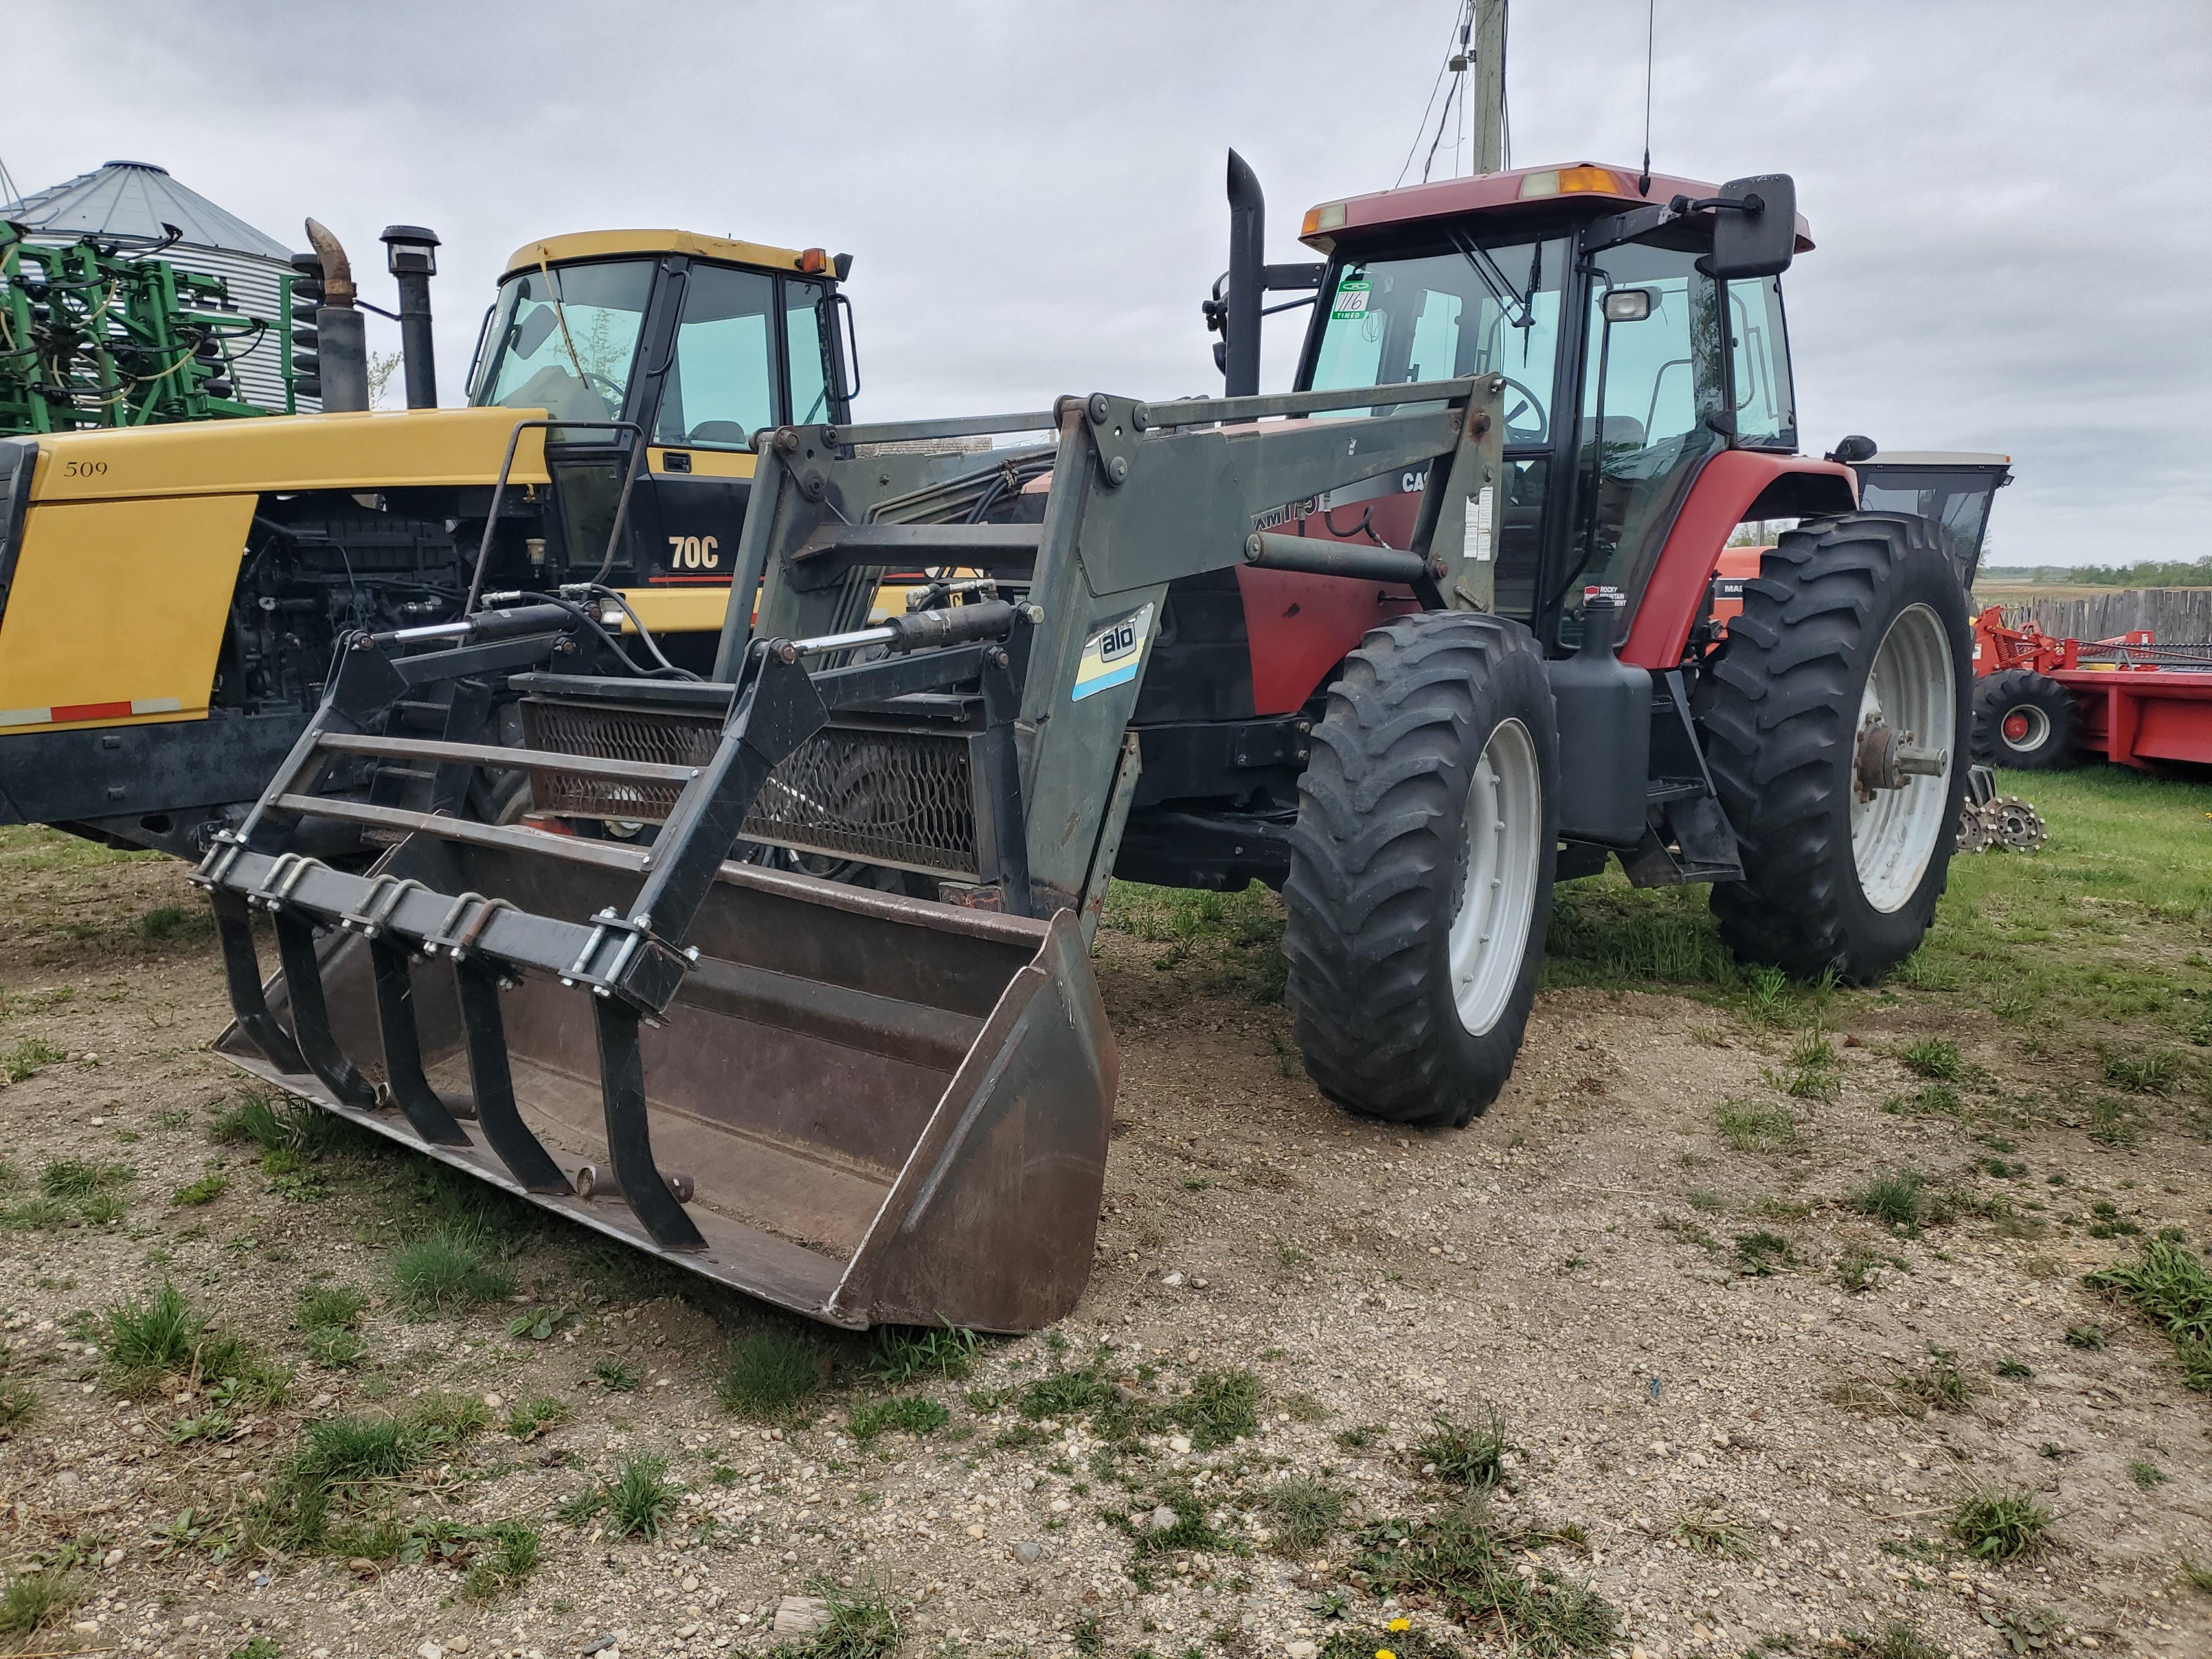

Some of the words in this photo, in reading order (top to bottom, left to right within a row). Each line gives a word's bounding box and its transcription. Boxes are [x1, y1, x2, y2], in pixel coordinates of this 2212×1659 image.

[1339, 292, 1362, 312] 116
[64, 462, 108, 477] 509
[1402, 472, 1428, 493] CA
[669, 536, 718, 568] 70C
